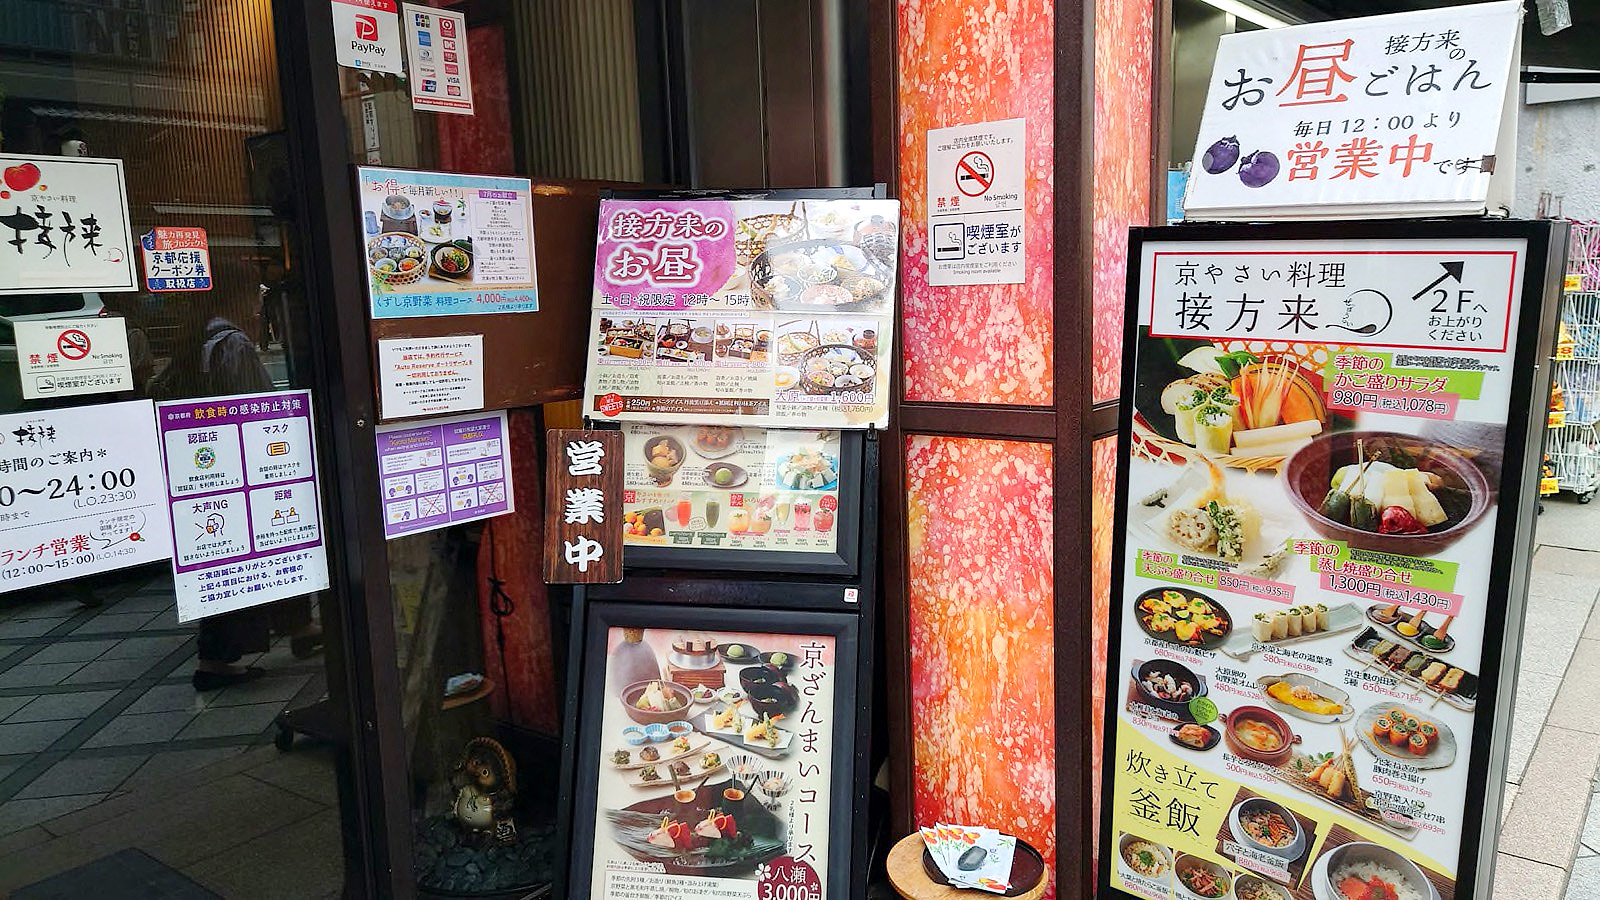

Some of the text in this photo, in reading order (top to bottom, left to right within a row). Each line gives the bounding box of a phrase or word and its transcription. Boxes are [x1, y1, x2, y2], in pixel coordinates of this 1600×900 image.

[351, 41, 386, 57] PayPay
[1221, 38, 1492, 111] お昼ごはん
[937, 196, 960, 208] 禁煙
[993, 193, 1018, 202] Smoking
[612, 210, 725, 240] 接方来の
[966, 223, 1022, 241] 喫煙室が
[152, 251, 202, 264] 京都応援
[967, 242, 1022, 256] ございます
[151, 264, 206, 277] クーポン券
[612, 246, 697, 282] お昼
[1174, 260, 1346, 288] 京やさい料理
[165, 279, 196, 289] 取扱店
[601, 294, 675, 306] 土・日・祝限定
[724, 294, 750, 306] 15時
[1174, 291, 1320, 334] 接方来
[1428, 315, 1483, 329] お上がり
[1428, 330, 1483, 342] ください
[29, 352, 59, 365] 禁煙
[1335, 355, 1384, 370] 季節の
[1334, 373, 1448, 393] かご盛りサラダ
[194, 399, 302, 421] 飲食時の感染防止対策
[1333, 390, 1449, 415] 980円 (税込1,078円)
[187, 430, 218, 444] 認証店
[262, 423, 290, 434] マスク
[73, 488, 137, 510] (L.O.23:30)
[274, 488, 293, 501] 距離
[192, 498, 229, 514] 大声NG
[564, 441, 605, 573] 営業中
[1, 534, 92, 567] ランチ営業
[1294, 541, 1340, 556] 季節の
[1142, 551, 1173, 564] 季節の
[1143, 563, 1215, 585] 天ぷら盛り合せ
[1318, 557, 1413, 584] 蒸し焼盛り合せ
[1219, 575, 1250, 591] 850円
[1328, 574, 1453, 609] 1,300円 (税込1,430円)
[797, 641, 827, 863] 京ざんまいコース
[1126, 748, 1219, 800] 炊き立て
[1129, 787, 1200, 837] 釜飯
[771, 865, 808, 884] 八瀬
